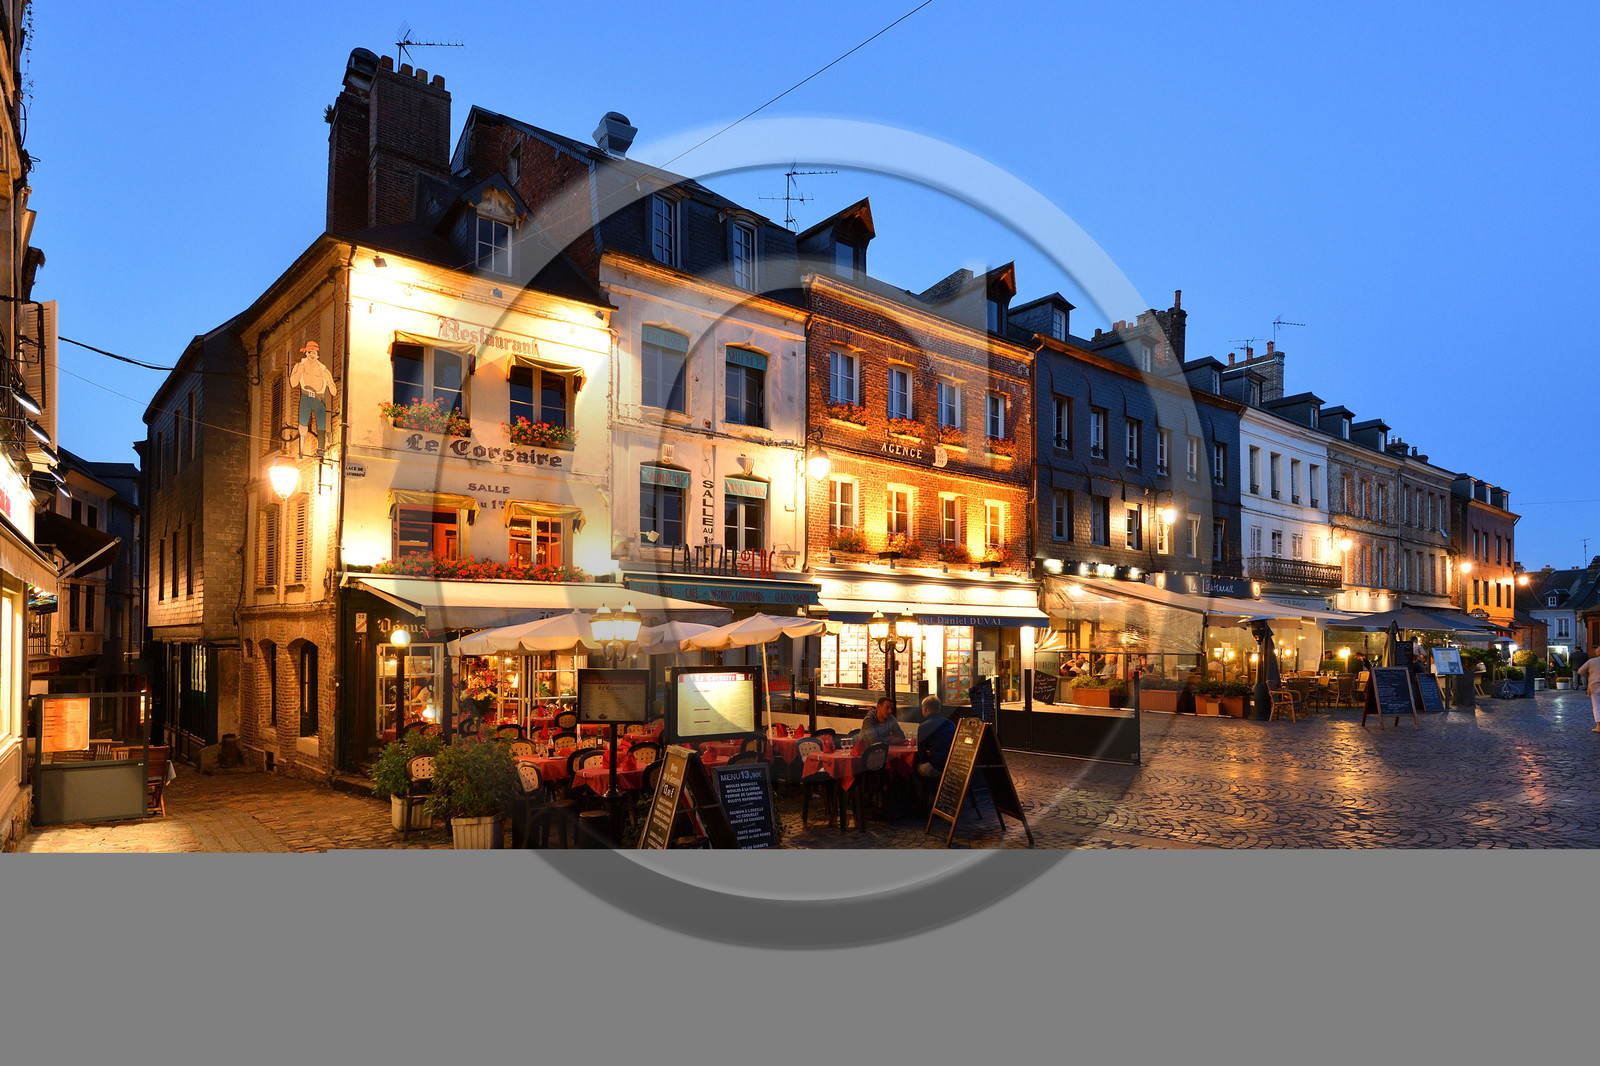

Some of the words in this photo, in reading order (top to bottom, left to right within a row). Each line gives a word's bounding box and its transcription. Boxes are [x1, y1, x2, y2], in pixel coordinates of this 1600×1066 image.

[437, 315, 541, 358] Restaurant
[663, 334, 681, 349] RESTO
[728, 351, 744, 365] SALLE
[406, 433, 439, 452] Le
[450, 439, 563, 468] Corsaire
[881, 441, 922, 459] AGENCE
[647, 471, 664, 484] SALON
[665, 473, 672, 485] DE
[468, 482, 510, 494] SALLE
[702, 480, 714, 527] SALLE
[751, 547, 776, 579] LUC
[656, 586, 673, 598] RESTO
[685, 587, 698, 599] CAFÉ
[937, 615, 967, 625] Daniel
[970, 617, 1004, 626] DUVAL
[720, 772, 741, 781] MENU
